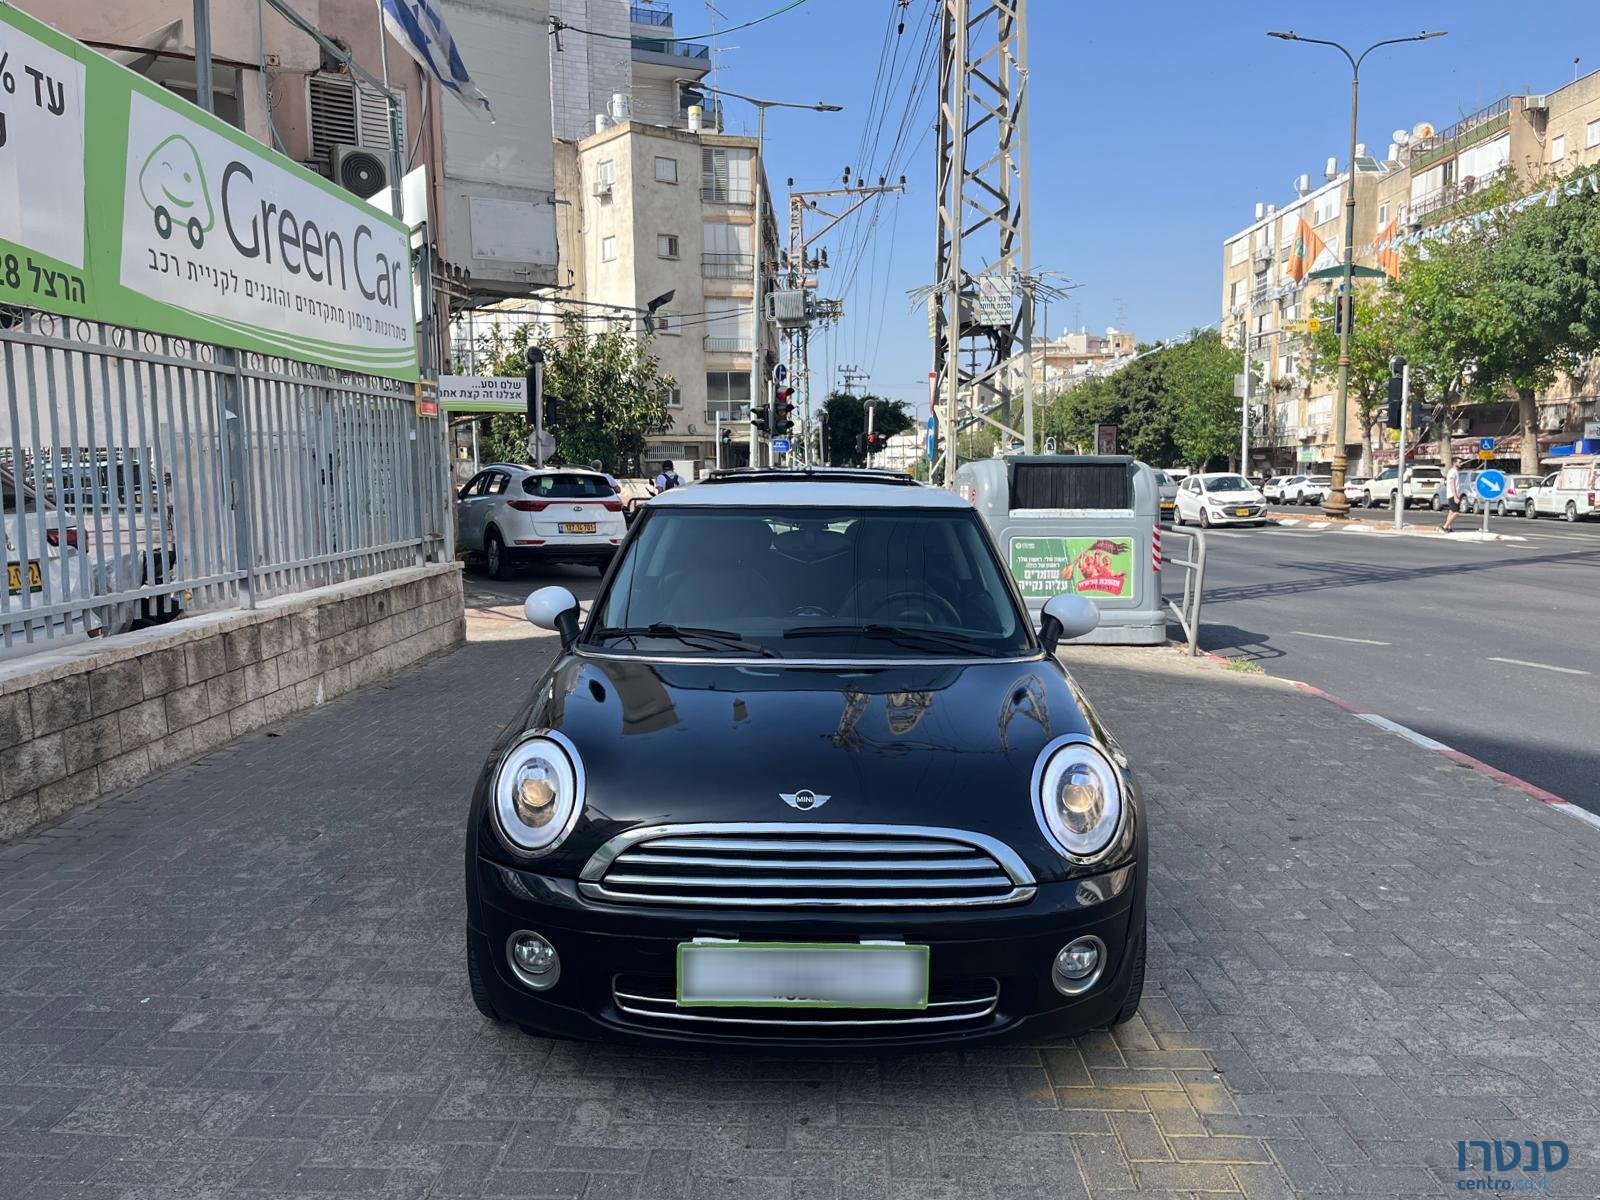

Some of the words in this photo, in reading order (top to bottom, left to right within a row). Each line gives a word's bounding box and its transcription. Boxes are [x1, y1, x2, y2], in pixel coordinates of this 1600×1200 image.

[25, 65, 65, 116] עד
[221, 161, 346, 291] Green
[353, 224, 401, 309] Car
[0, 254, 20, 288] 8
[148, 248, 180, 277] רכב
[27, 257, 86, 304] הרצל
[187, 261, 238, 296] לקניית
[245, 279, 290, 308] והוגנים
[296, 295, 344, 324] מתקדמים
[348, 311, 372, 331] מימון
[375, 320, 407, 341] פתרונות
[459, 389, 480, 400] קצת
[482, 390, 493, 399] זה
[496, 390, 522, 399] אצלנו
[501, 380, 521, 389] שלם
[1018, 580, 1043, 592] נקייה
[1024, 570, 1059, 579] שומרים
